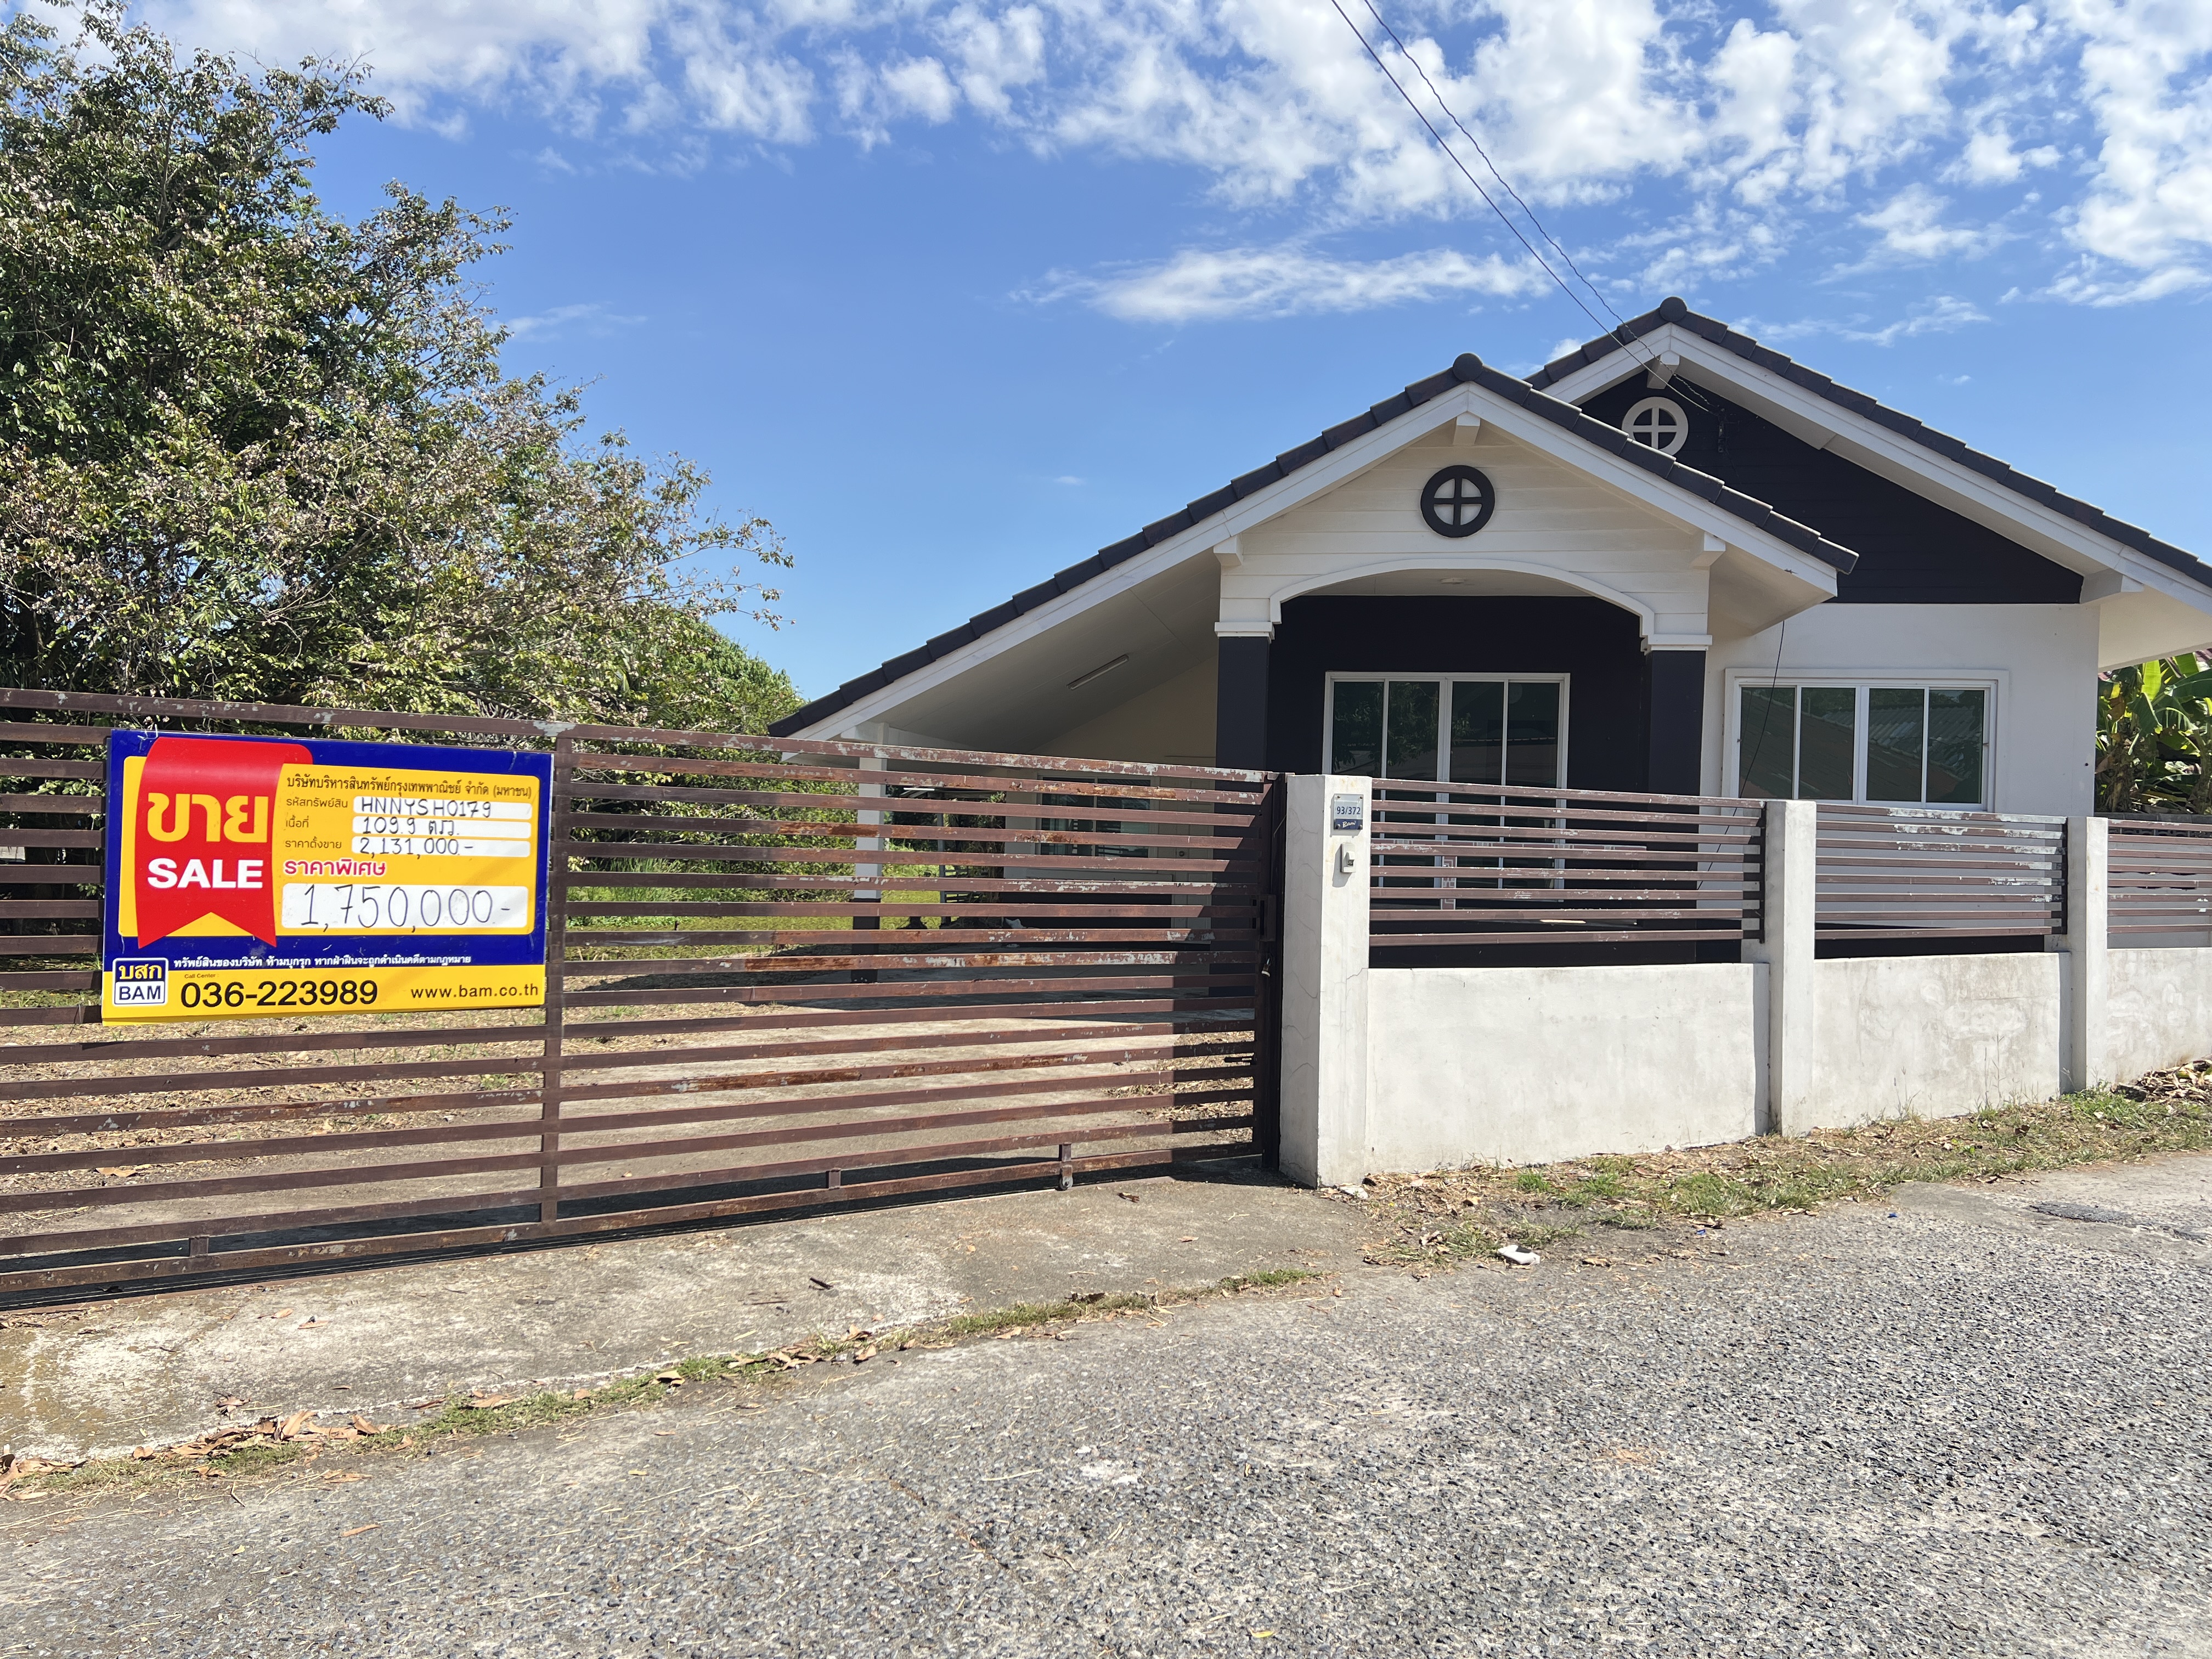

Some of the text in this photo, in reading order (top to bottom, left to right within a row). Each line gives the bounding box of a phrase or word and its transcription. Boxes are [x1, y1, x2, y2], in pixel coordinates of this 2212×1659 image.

[287, 773, 532, 799] บริษัทบริหารสินทรัพย์กรุงเทพพาณิชย์ จำกัด (มหาชน)
[286, 797, 348, 809] รหัสทรัพย์สิน
[1336, 806, 1361, 815] 93/372
[147, 792, 269, 843] ขาย
[286, 814, 309, 828] เนื้อที่
[285, 836, 342, 849] ราคาตั้งขาย
[147, 857, 264, 889] SALE
[284, 858, 386, 876] ราคาพิเศษ
[173, 955, 263, 968] ทรัพย์สินของบริษัท
[266, 955, 311, 969] ห้ามบุกรุก
[119, 963, 162, 980] บสก
[119, 985, 161, 1001] BAM
[180, 980, 377, 1008] 036-223989
[410, 983, 539, 998] www.bam.co.th
